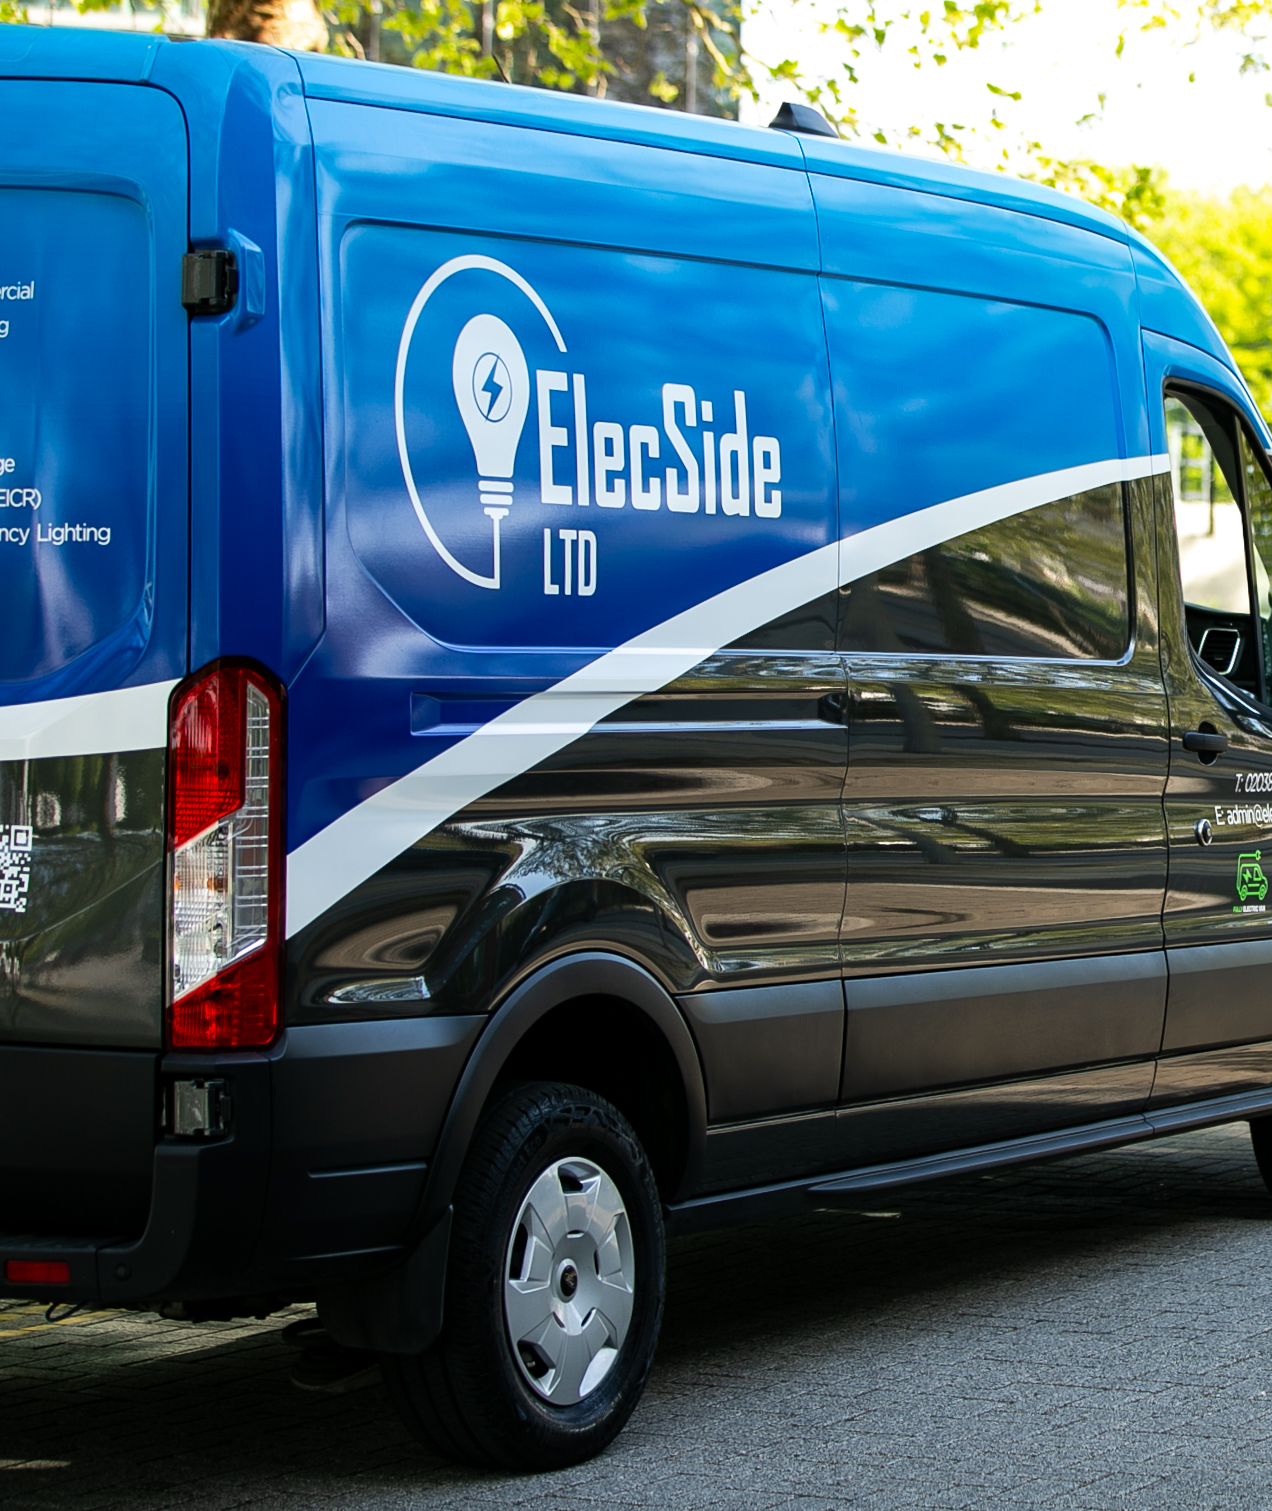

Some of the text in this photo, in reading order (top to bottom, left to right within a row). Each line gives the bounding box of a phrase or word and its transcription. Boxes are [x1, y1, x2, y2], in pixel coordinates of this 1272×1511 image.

[536, 369, 782, 519] ElecSide
[37, 522, 111, 546] Lighting
[543, 528, 597, 597] LTD
[1234, 773, 1244, 793] T:
[1214, 805, 1226, 826] E:
